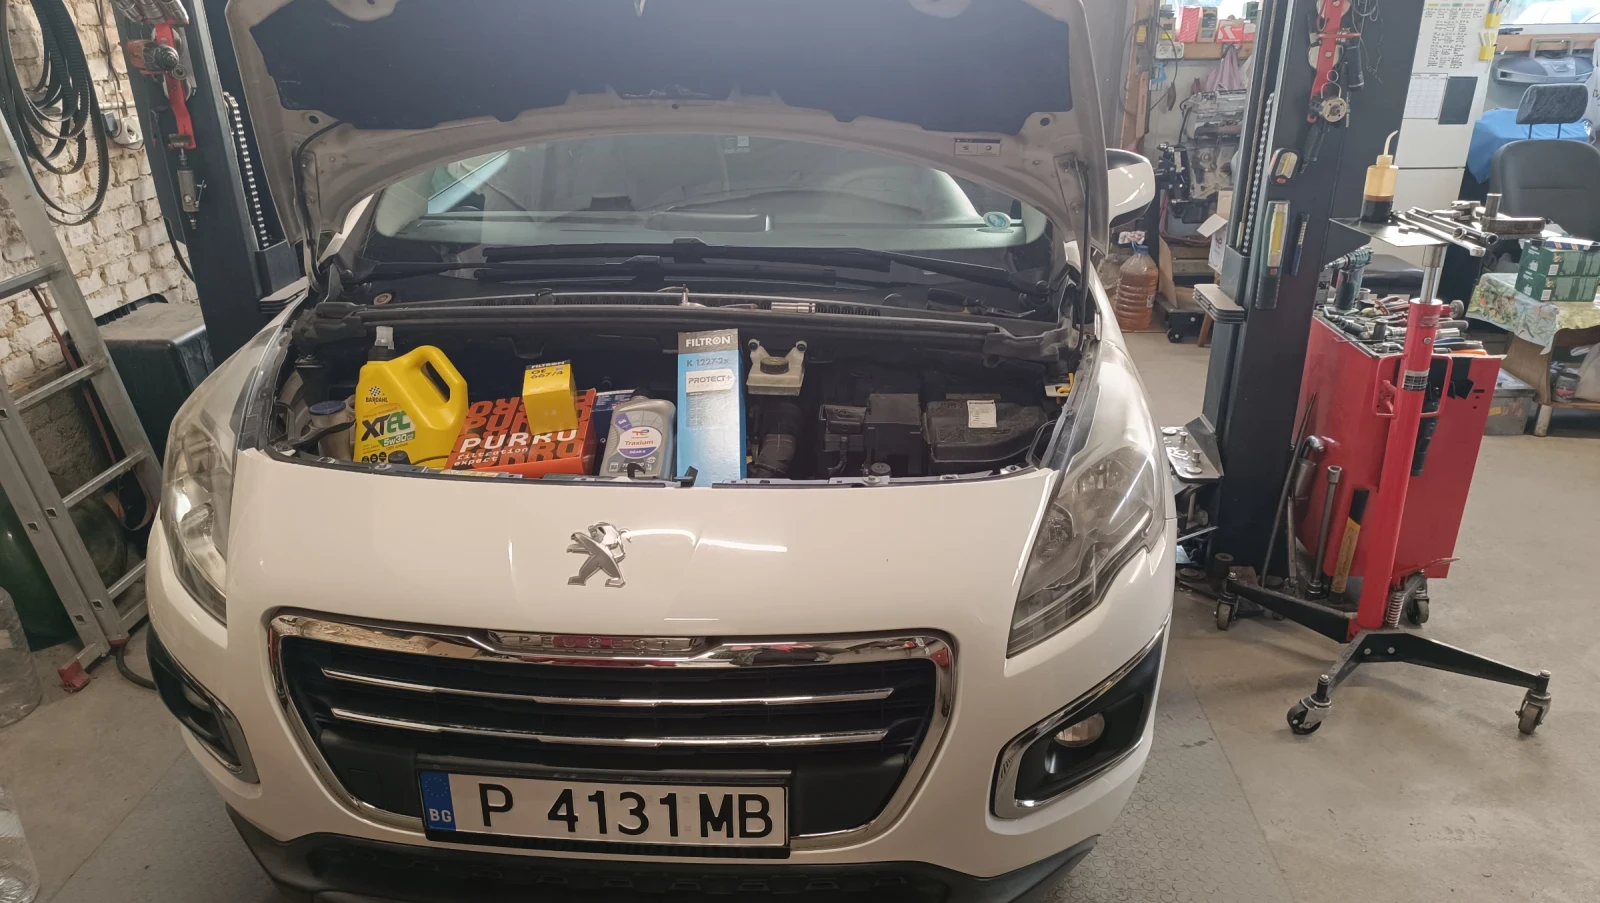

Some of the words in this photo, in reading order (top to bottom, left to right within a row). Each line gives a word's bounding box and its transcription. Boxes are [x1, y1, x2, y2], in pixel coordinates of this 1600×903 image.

[685, 335, 731, 347] FILTRON
[531, 361, 565, 369] FILTRON
[361, 410, 410, 442] XTEC
[456, 447, 528, 461] filtration
[453, 456, 498, 467] expert
[518, 635, 671, 650] PEUGEOT
[429, 807, 452, 823] BG
[478, 782, 514, 827] P
[547, 788, 679, 837] 4131
[699, 792, 774, 839] MB
